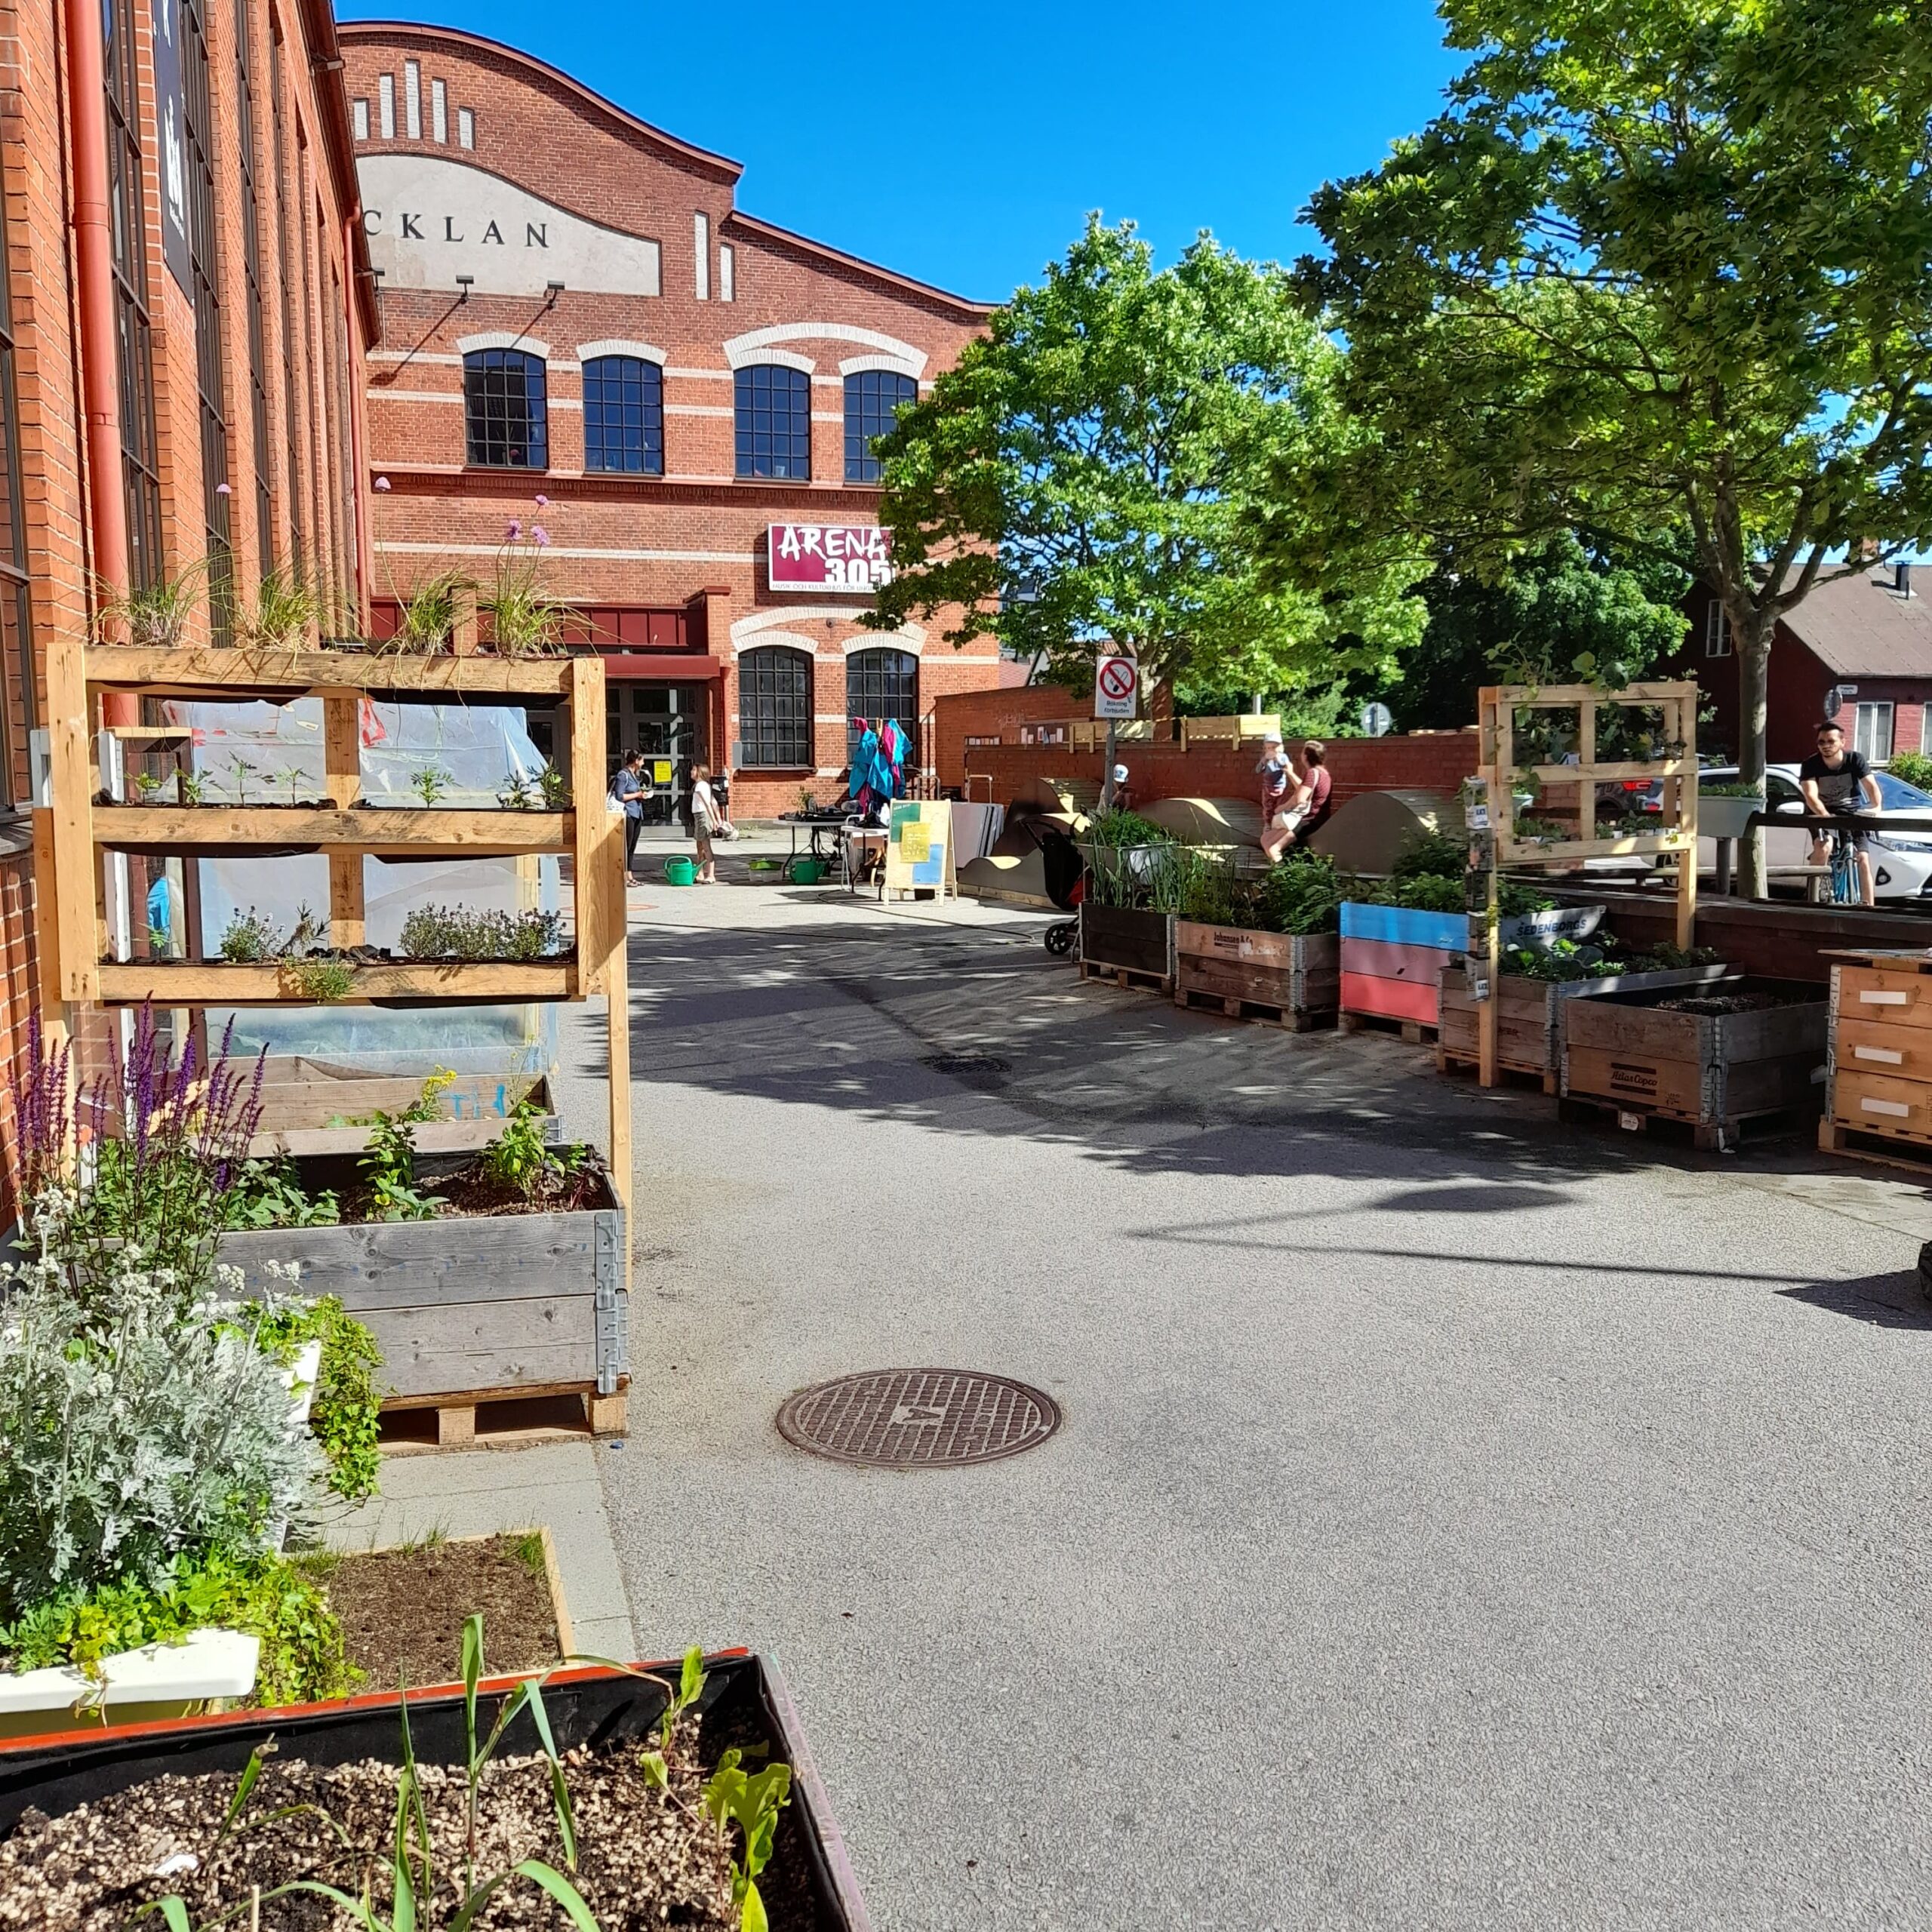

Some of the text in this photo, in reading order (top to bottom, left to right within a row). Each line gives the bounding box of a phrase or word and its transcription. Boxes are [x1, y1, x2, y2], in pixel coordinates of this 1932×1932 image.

[777, 525, 887, 561] ARENA
[825, 558, 891, 586] 305
[1611, 1070, 1658, 1087] Atlas Copco
